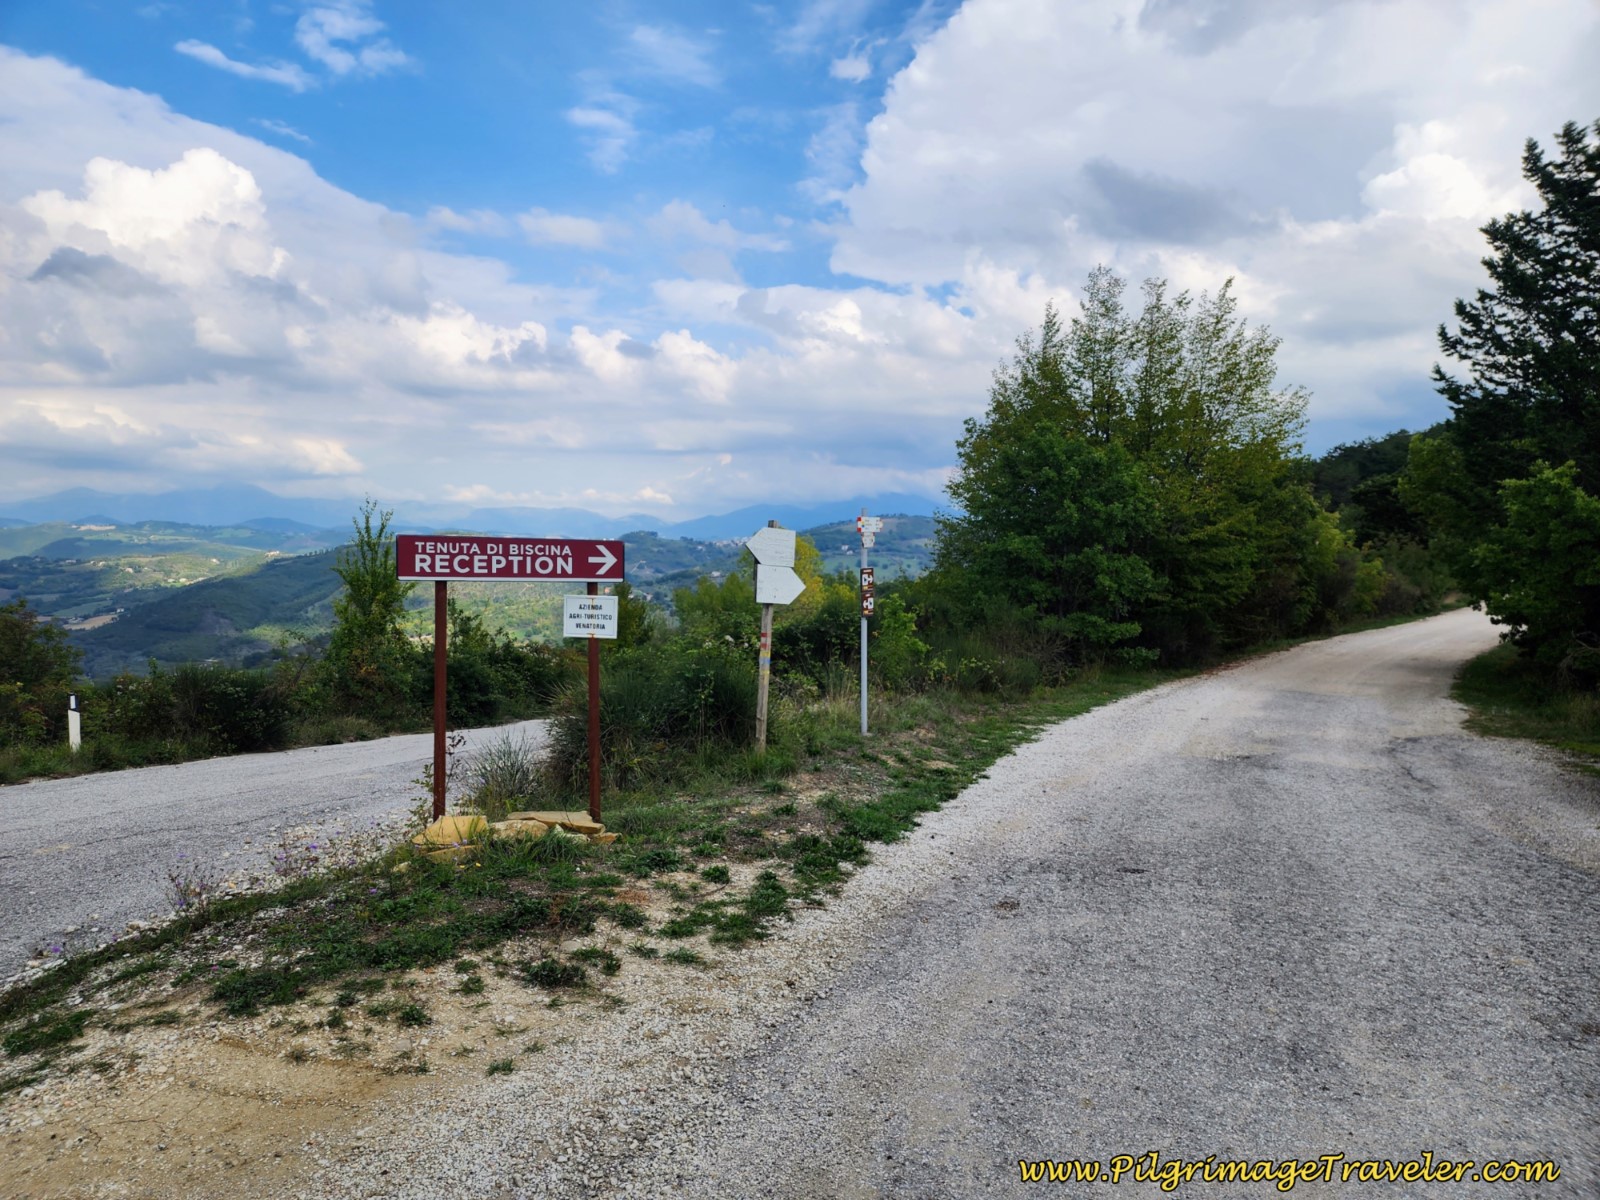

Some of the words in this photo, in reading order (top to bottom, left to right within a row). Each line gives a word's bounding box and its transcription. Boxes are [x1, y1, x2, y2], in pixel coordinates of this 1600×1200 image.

[415, 542, 480, 554] TENUTA
[487, 544, 502, 554] DI
[511, 545, 572, 556] BISCINA
[415, 554, 573, 574] RECEPTION
